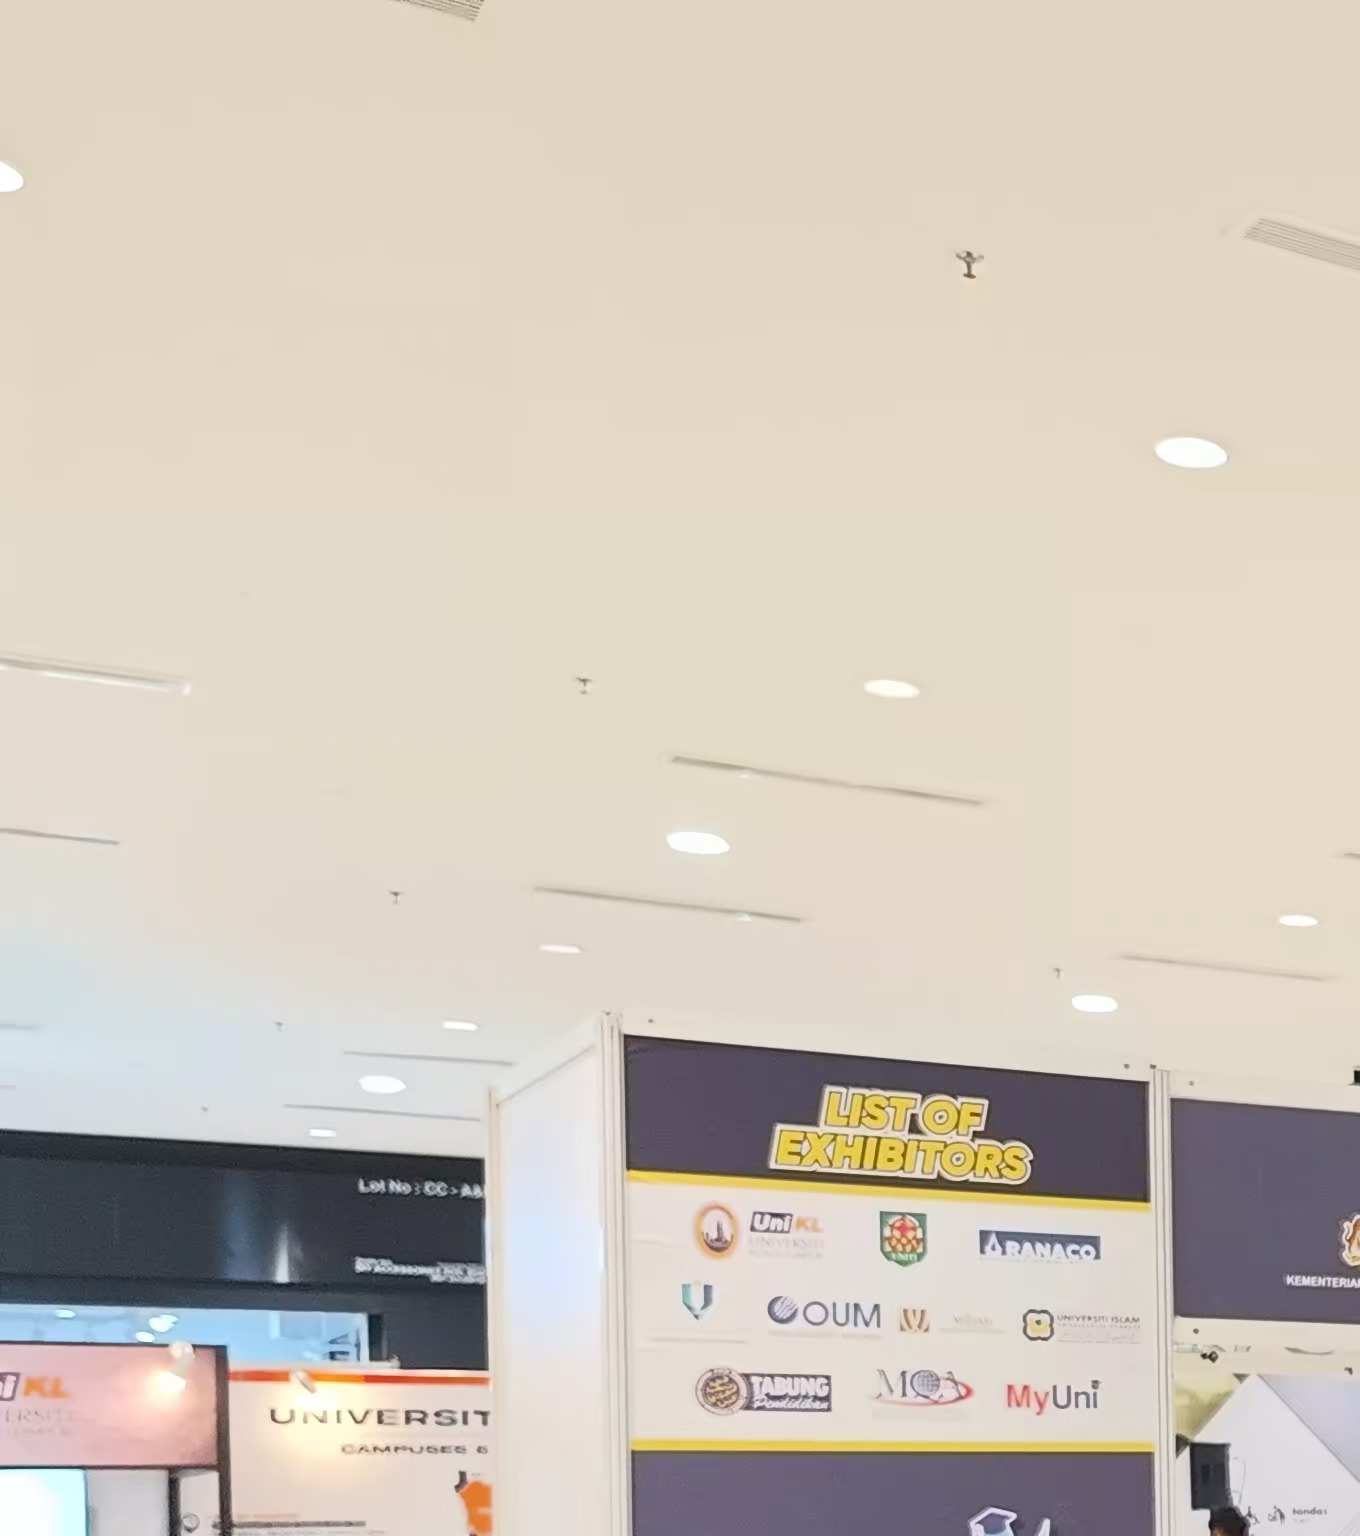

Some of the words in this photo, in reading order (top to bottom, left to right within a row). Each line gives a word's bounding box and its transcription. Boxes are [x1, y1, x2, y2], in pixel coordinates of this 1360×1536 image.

[825, 1091, 915, 1132] LIST
[922, 1096, 985, 1137] OF
[773, 1130, 1031, 1181] EXHIBITORS
[803, 1301, 881, 1329] OUM
[750, 1375, 830, 1398] TABUNG
[1006, 1379, 1101, 1415] MyUni
[341, 1443, 467, 1456] CAMPUSES
